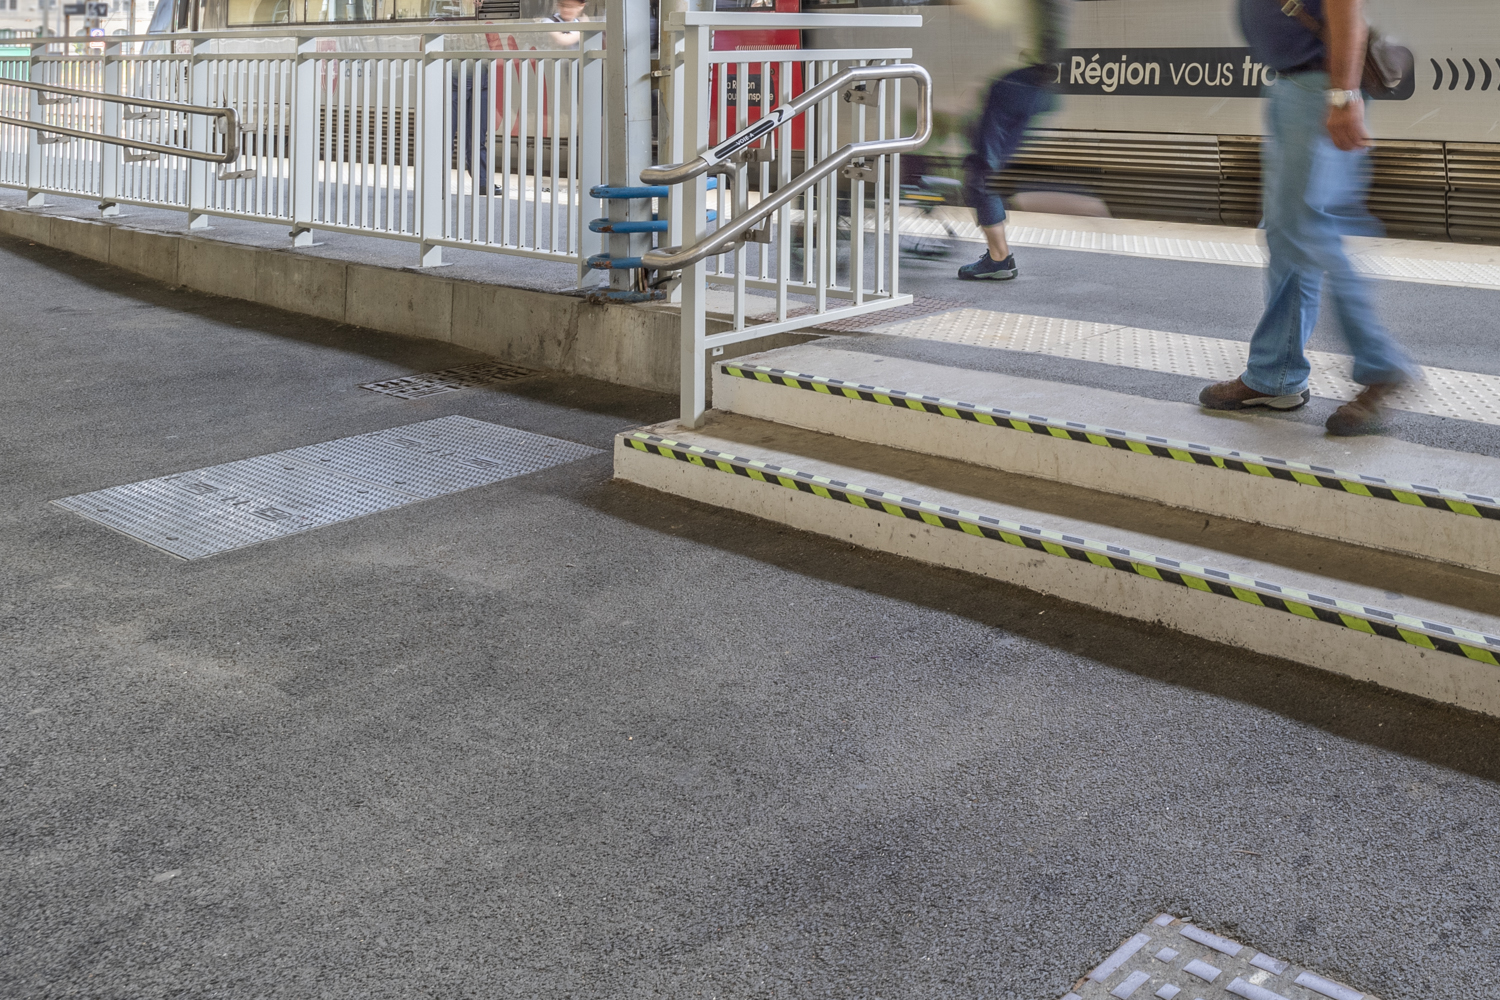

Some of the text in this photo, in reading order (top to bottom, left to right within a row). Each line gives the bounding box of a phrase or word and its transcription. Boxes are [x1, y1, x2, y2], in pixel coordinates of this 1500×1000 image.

[1069, 53, 1161, 93] Région
[1169, 61, 1234, 87] vous
[735, 134, 750, 146] VOIE
